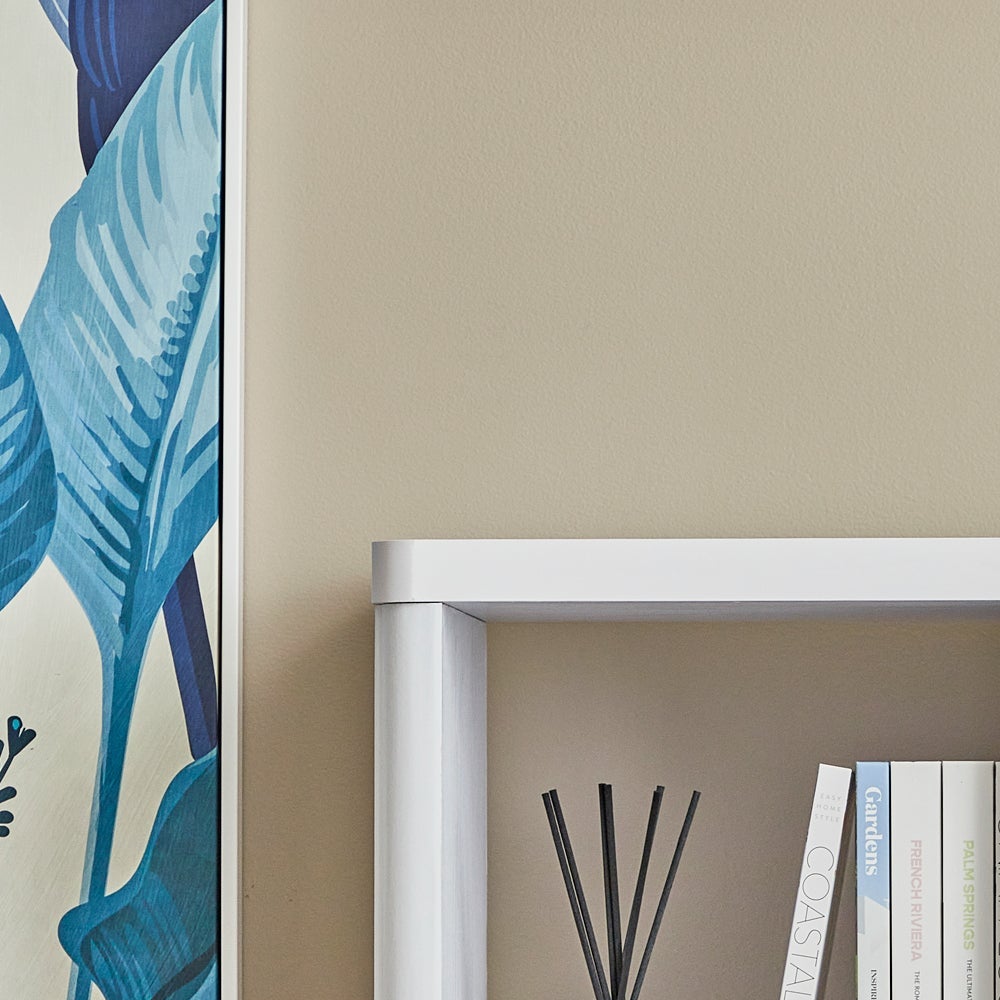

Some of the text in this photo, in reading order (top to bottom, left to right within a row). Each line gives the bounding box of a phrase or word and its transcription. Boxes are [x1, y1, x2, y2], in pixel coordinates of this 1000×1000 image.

[814, 813, 840, 823] STYLE
[816, 803, 841, 813] HOME
[820, 793, 842, 802] EASY
[864, 786, 883, 876] Gardens
[910, 840, 923, 962] FRENCH RIVIERA
[962, 840, 975, 950] PALM SPRINGS
